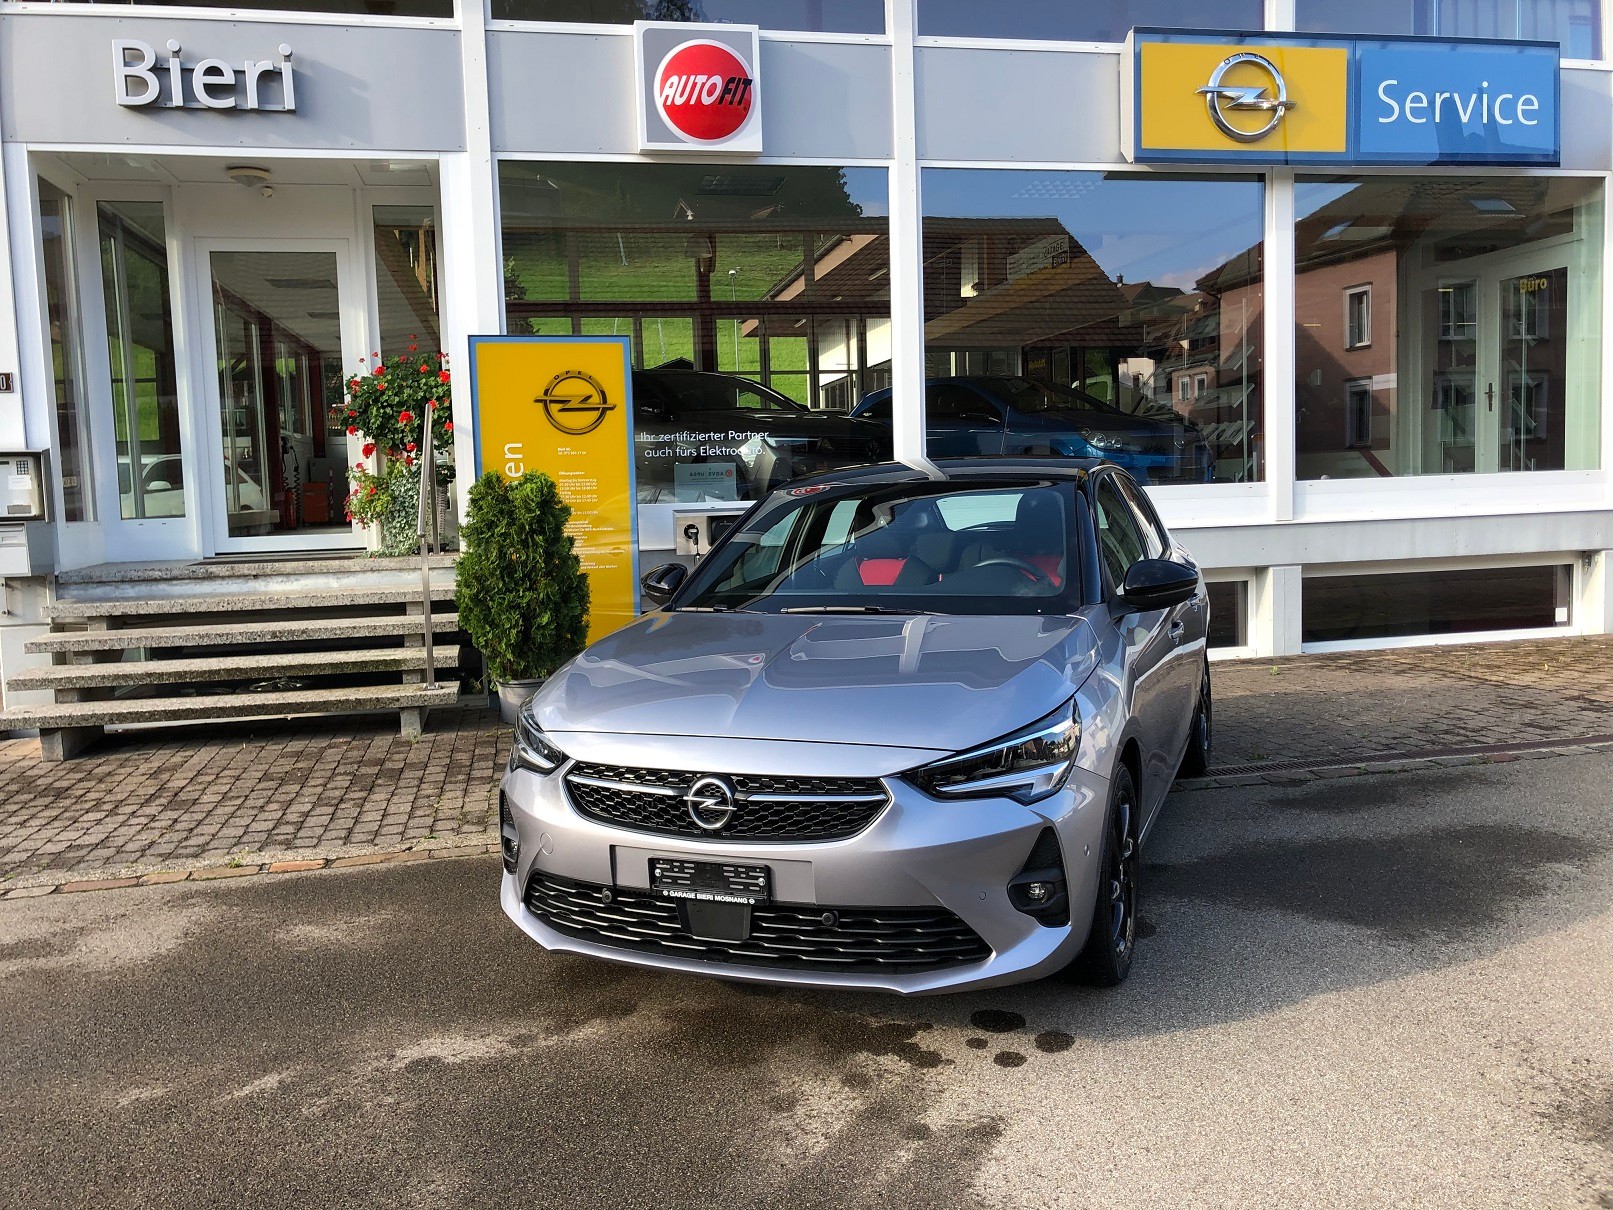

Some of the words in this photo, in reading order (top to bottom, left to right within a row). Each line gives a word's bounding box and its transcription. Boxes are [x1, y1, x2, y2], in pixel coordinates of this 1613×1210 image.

[111, 38, 296, 110] Bieri
[660, 74, 753, 106] AUTOFIT
[1377, 79, 1539, 125] Service
[1520, 277, 1547, 292] Büro
[553, 370, 593, 381] OPEL
[640, 431, 655, 442] Ihr
[658, 430, 726, 442] zertifizierter
[728, 430, 770, 440] Partner
[644, 446, 673, 457] auch
[675, 446, 697, 457] fürs
[669, 889, 696, 899] GARAGE
[696, 892, 713, 901] BIERI
[714, 894, 748, 904] MOSNANG
